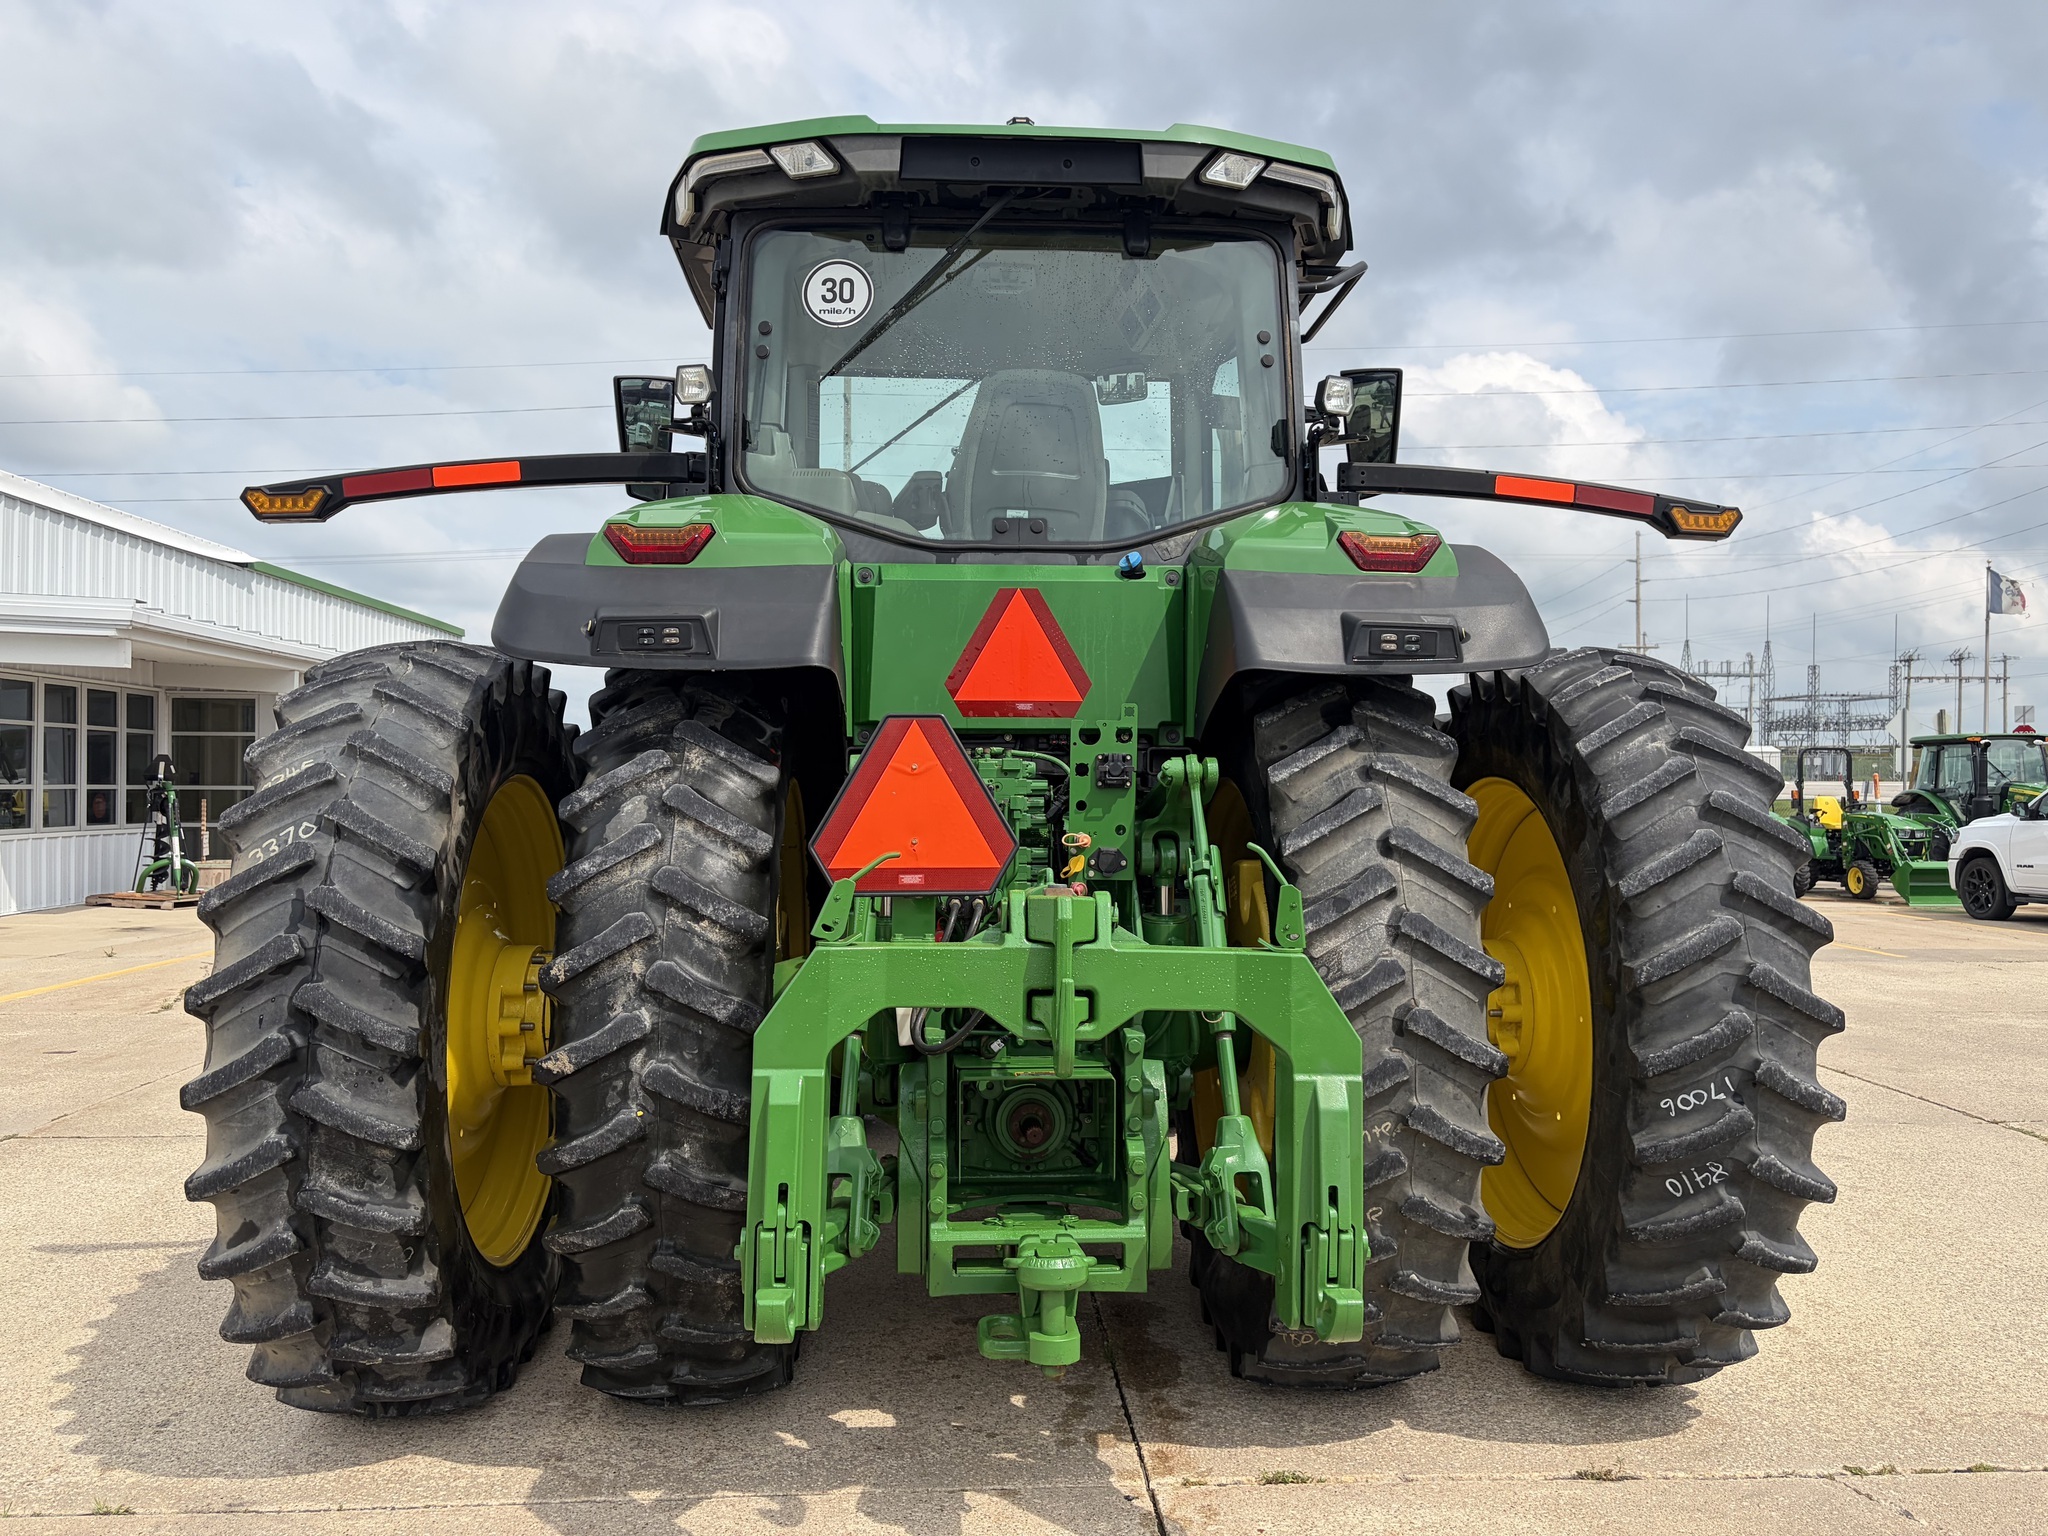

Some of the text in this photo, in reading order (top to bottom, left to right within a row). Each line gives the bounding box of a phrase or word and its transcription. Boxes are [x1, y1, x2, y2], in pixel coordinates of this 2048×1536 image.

[821, 277, 855, 304] 30
[818, 307, 857, 315] mile/h
[248, 821, 319, 864] 3370
[1660, 1076, 1735, 1117] 17006
[1665, 1161, 1730, 1198] 8410
